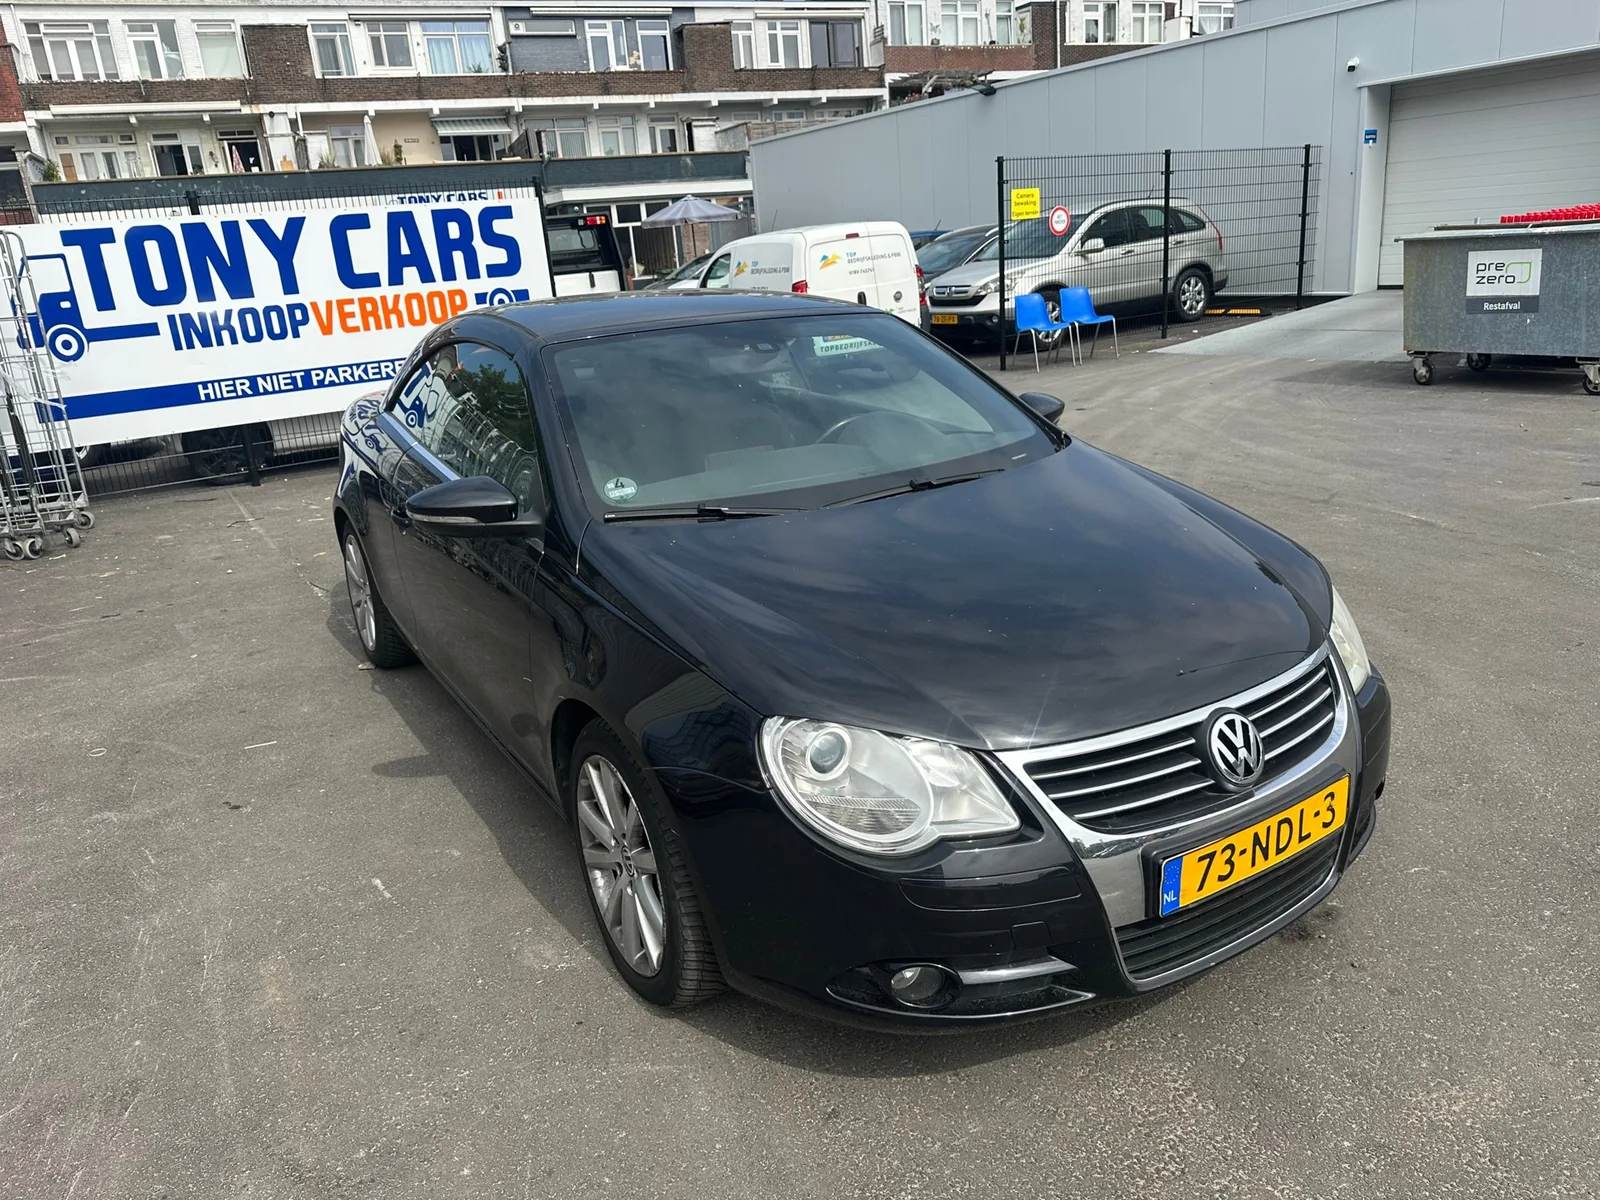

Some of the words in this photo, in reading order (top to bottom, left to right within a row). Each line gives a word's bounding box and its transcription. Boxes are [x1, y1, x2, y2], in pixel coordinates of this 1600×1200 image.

[60, 215, 306, 312] TONY
[329, 205, 522, 289] CARS
[1476, 262, 1506, 274] pre
[1476, 275, 1516, 284] zero
[1483, 301, 1521, 311] Restafval
[198, 378, 252, 401] HIER
[256, 371, 305, 394] NIET
[1196, 791, 1336, 893] 73-NDL-3
[1163, 890, 1177, 905] NL
